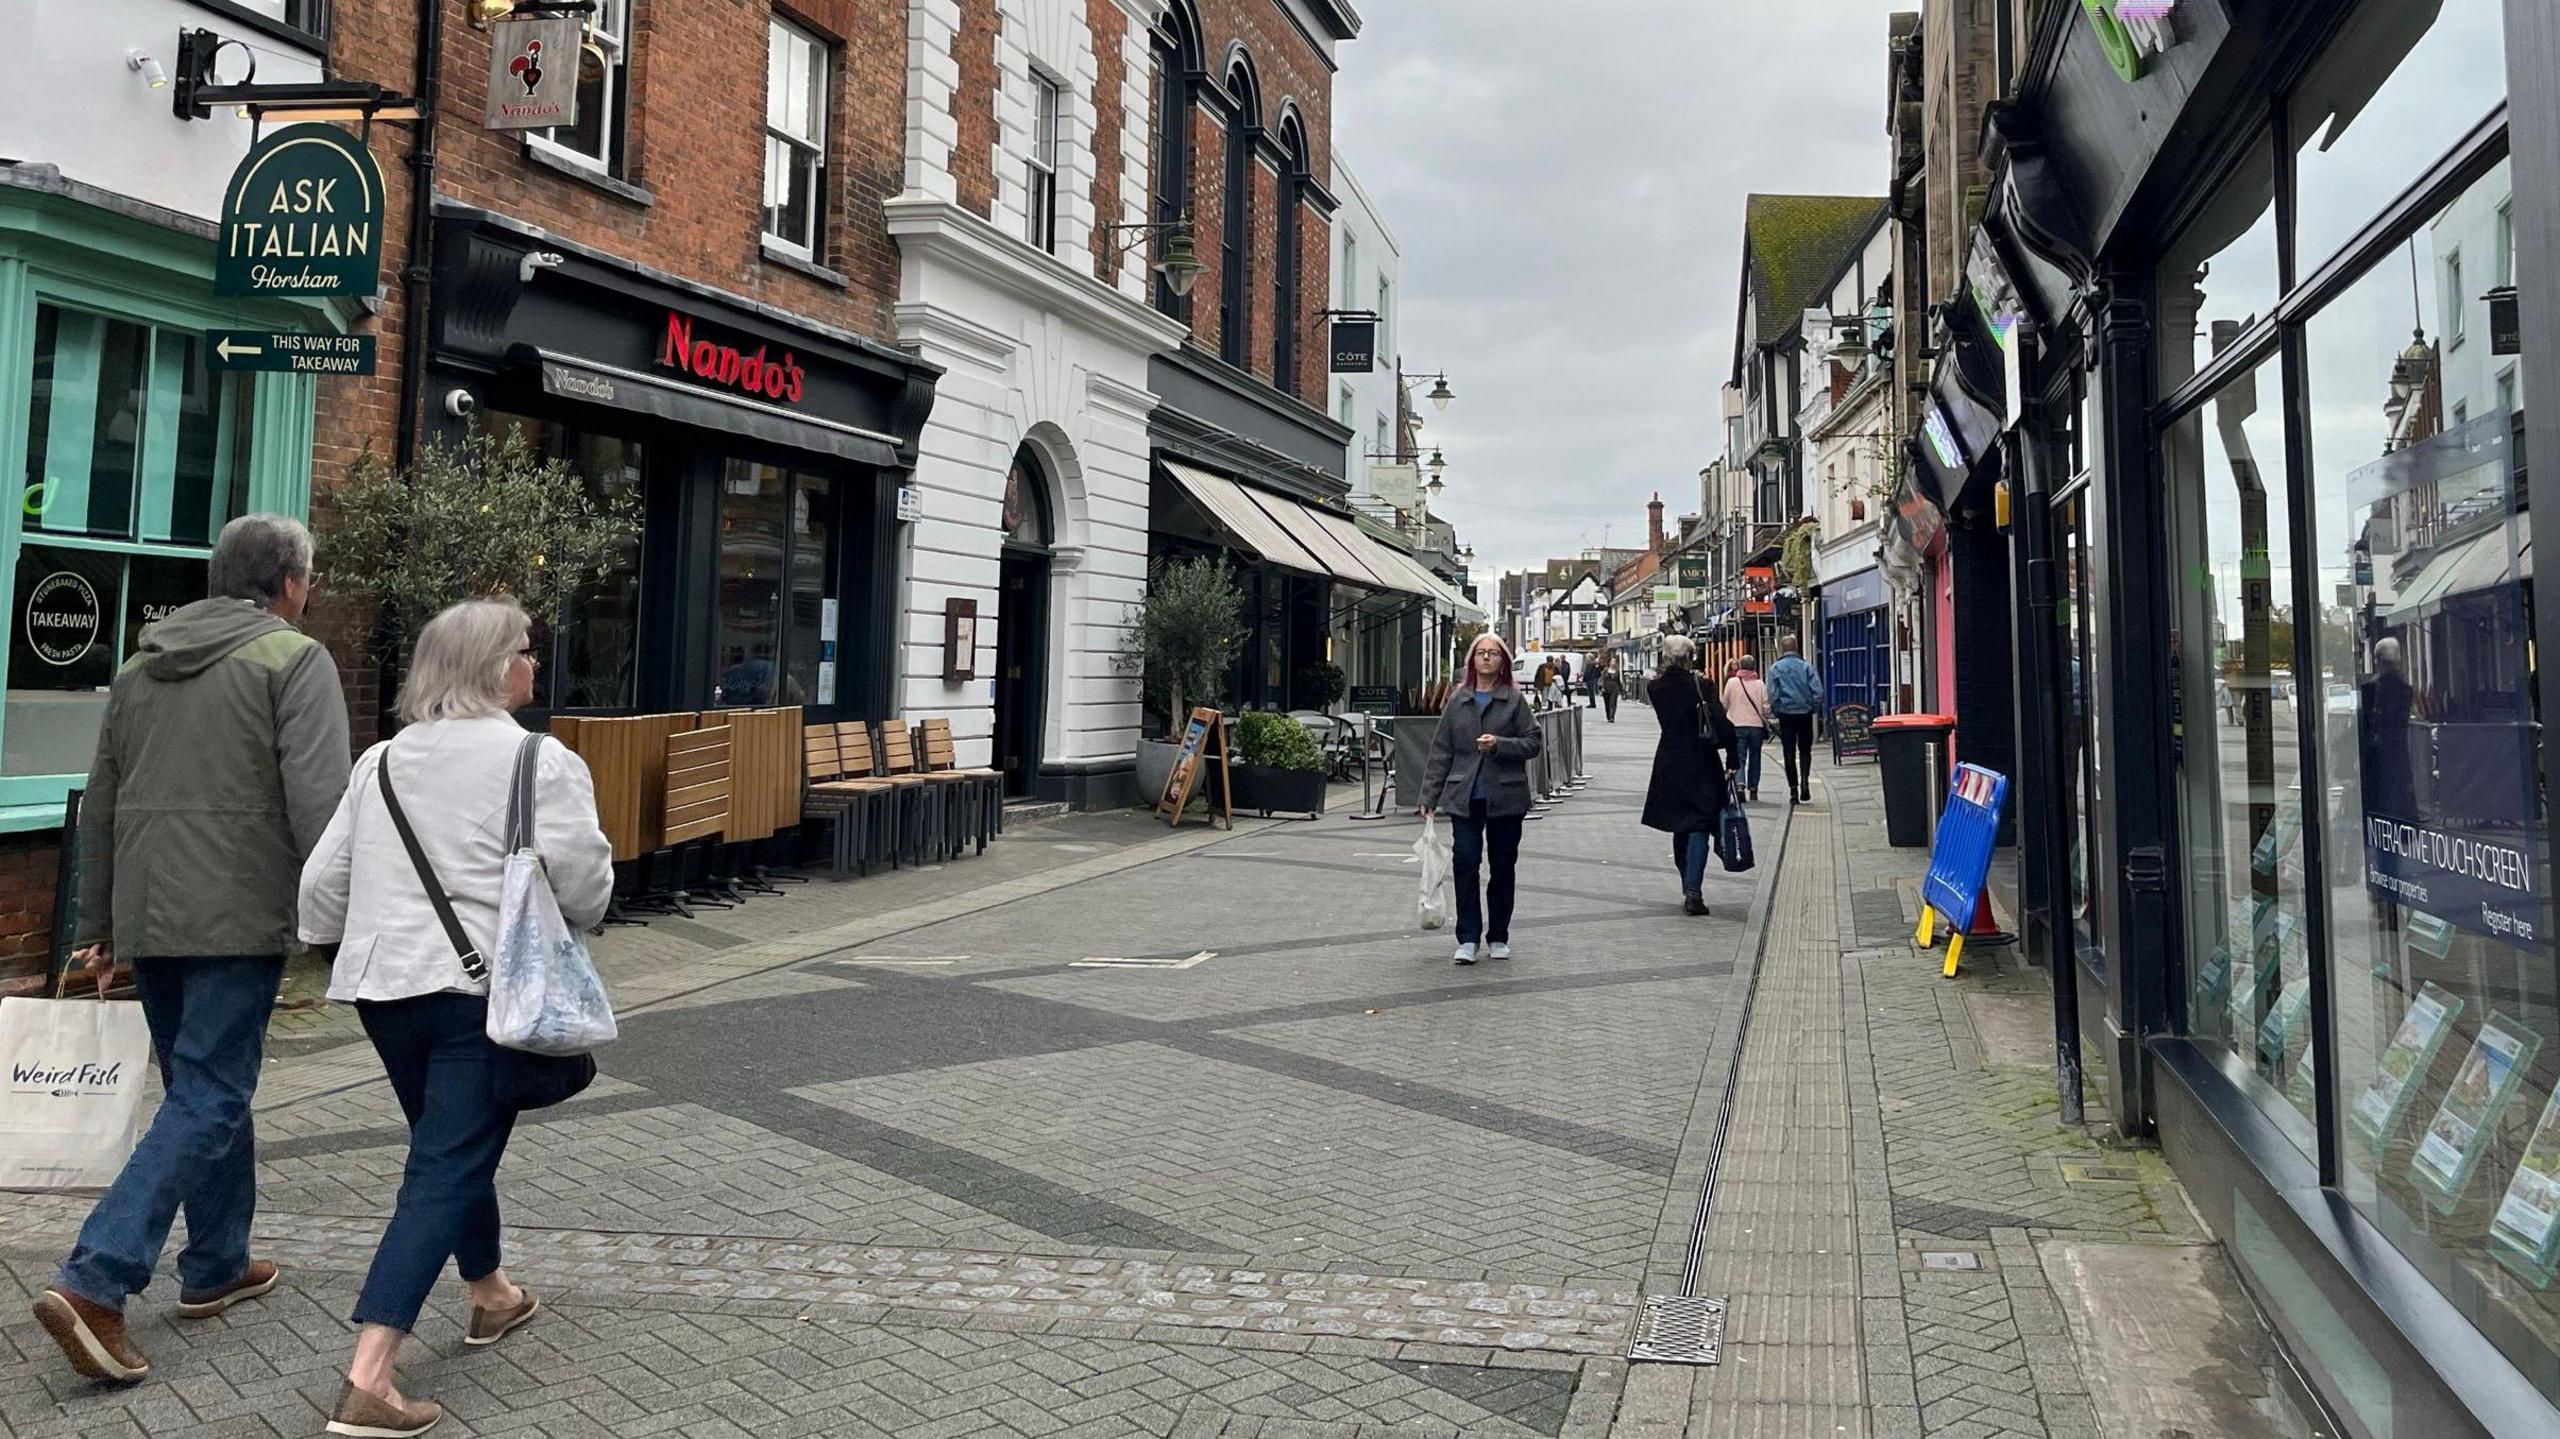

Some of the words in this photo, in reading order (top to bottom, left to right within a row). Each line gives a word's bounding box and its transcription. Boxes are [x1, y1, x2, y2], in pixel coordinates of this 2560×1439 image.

[501, 101, 560, 117] Nando's
[269, 178, 338, 214] ASK
[230, 222, 369, 257] ITALIAN
[251, 264, 341, 289] Horsham
[272, 335, 301, 350] THIS
[304, 337, 333, 351] WAY
[336, 338, 360, 352] FOR
[1336, 351, 1368, 361] CÔTE
[291, 355, 360, 372] TAKEAWAY
[663, 310, 805, 403] Nando's
[553, 367, 615, 400] Nando's
[36, 578, 78, 604] STONEBAKED
[78, 584, 93, 607] PIZZA
[32, 611, 96, 629] TAKEAWAY
[143, 604, 167, 620] Full
[40, 642, 61, 659] FRESH
[62, 643, 84, 659] PASTA
[2367, 816, 2429, 864] INTERACTIVE
[2429, 832, 2475, 877] TOUCH
[2475, 843, 2530, 892] SCREEN
[2399, 880, 2428, 903] properties
[2482, 901, 2512, 935] Register
[2513, 912, 2532, 940] here
[13, 1060, 77, 1084] Weird
[78, 1062, 121, 1086] Fish
